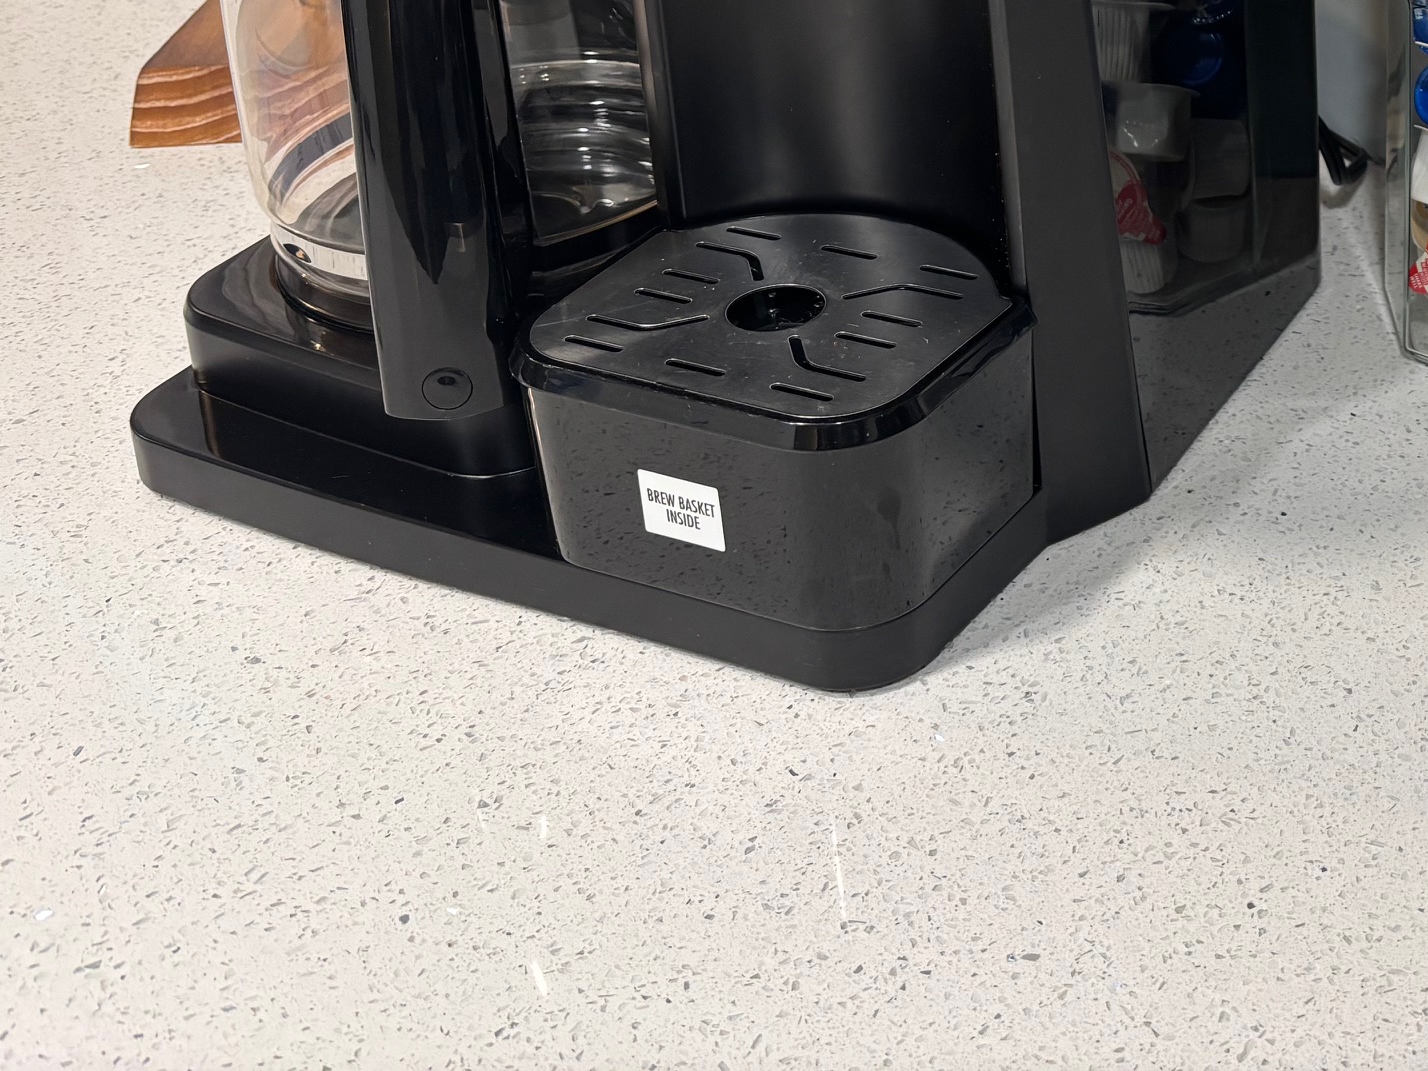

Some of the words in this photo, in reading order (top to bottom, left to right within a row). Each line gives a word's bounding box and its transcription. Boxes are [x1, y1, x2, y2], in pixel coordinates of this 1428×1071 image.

[647, 488, 675, 508] BREW
[678, 496, 715, 518] BASKET
[666, 509, 701, 530] INSIDE
